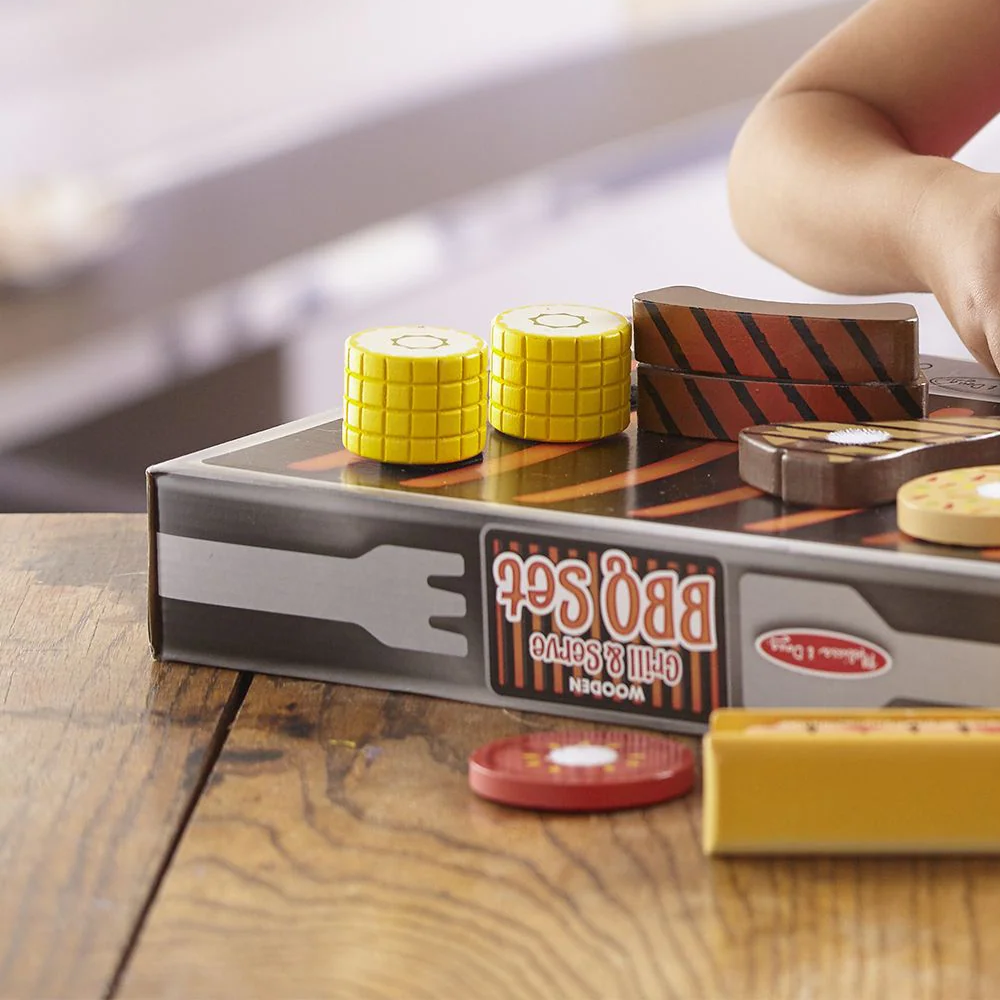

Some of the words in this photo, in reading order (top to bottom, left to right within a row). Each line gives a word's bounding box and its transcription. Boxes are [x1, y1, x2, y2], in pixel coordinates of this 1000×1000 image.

[493, 551, 593, 635] Set
[600, 549, 717, 650] BBQ
[529, 631, 603, 675] Serve
[604, 641, 625, 679] &
[627, 645, 682, 686] Grill
[569, 676, 646, 702] WOODEN
